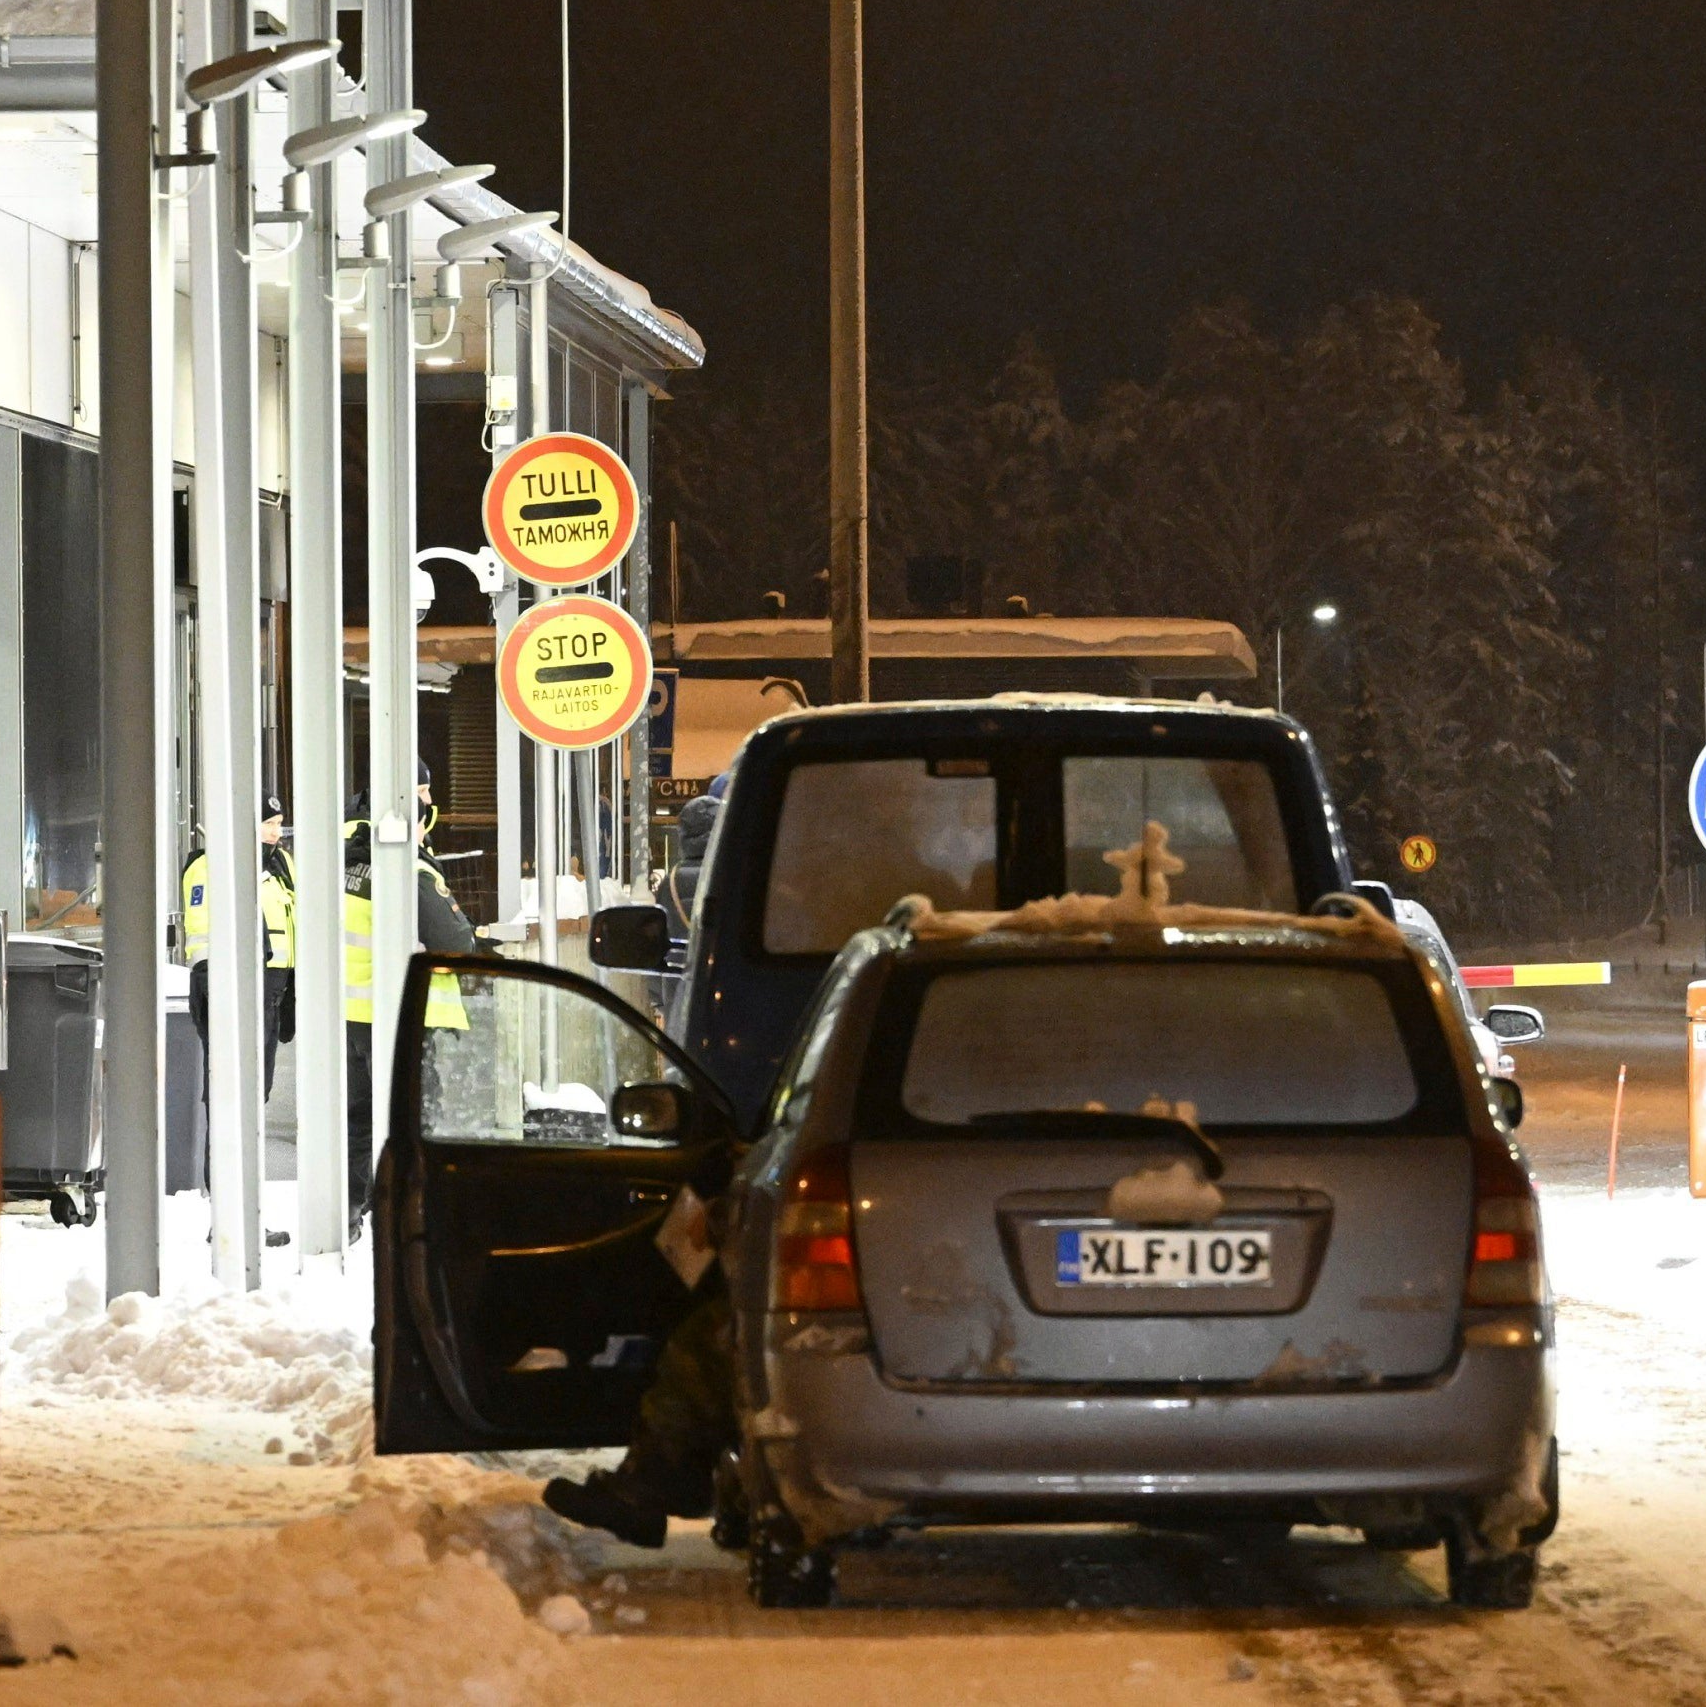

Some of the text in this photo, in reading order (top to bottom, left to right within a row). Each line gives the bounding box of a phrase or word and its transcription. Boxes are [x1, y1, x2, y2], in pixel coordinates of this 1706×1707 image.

[521, 469, 597, 499] TULLI
[513, 520, 609, 546] ТАМОЖНЯ
[536, 632, 608, 661] STOP
[532, 683, 619, 701] RAJAVARTIO-
[554, 699, 599, 715] LAITOS
[1088, 1239, 1263, 1274] XLF-109
